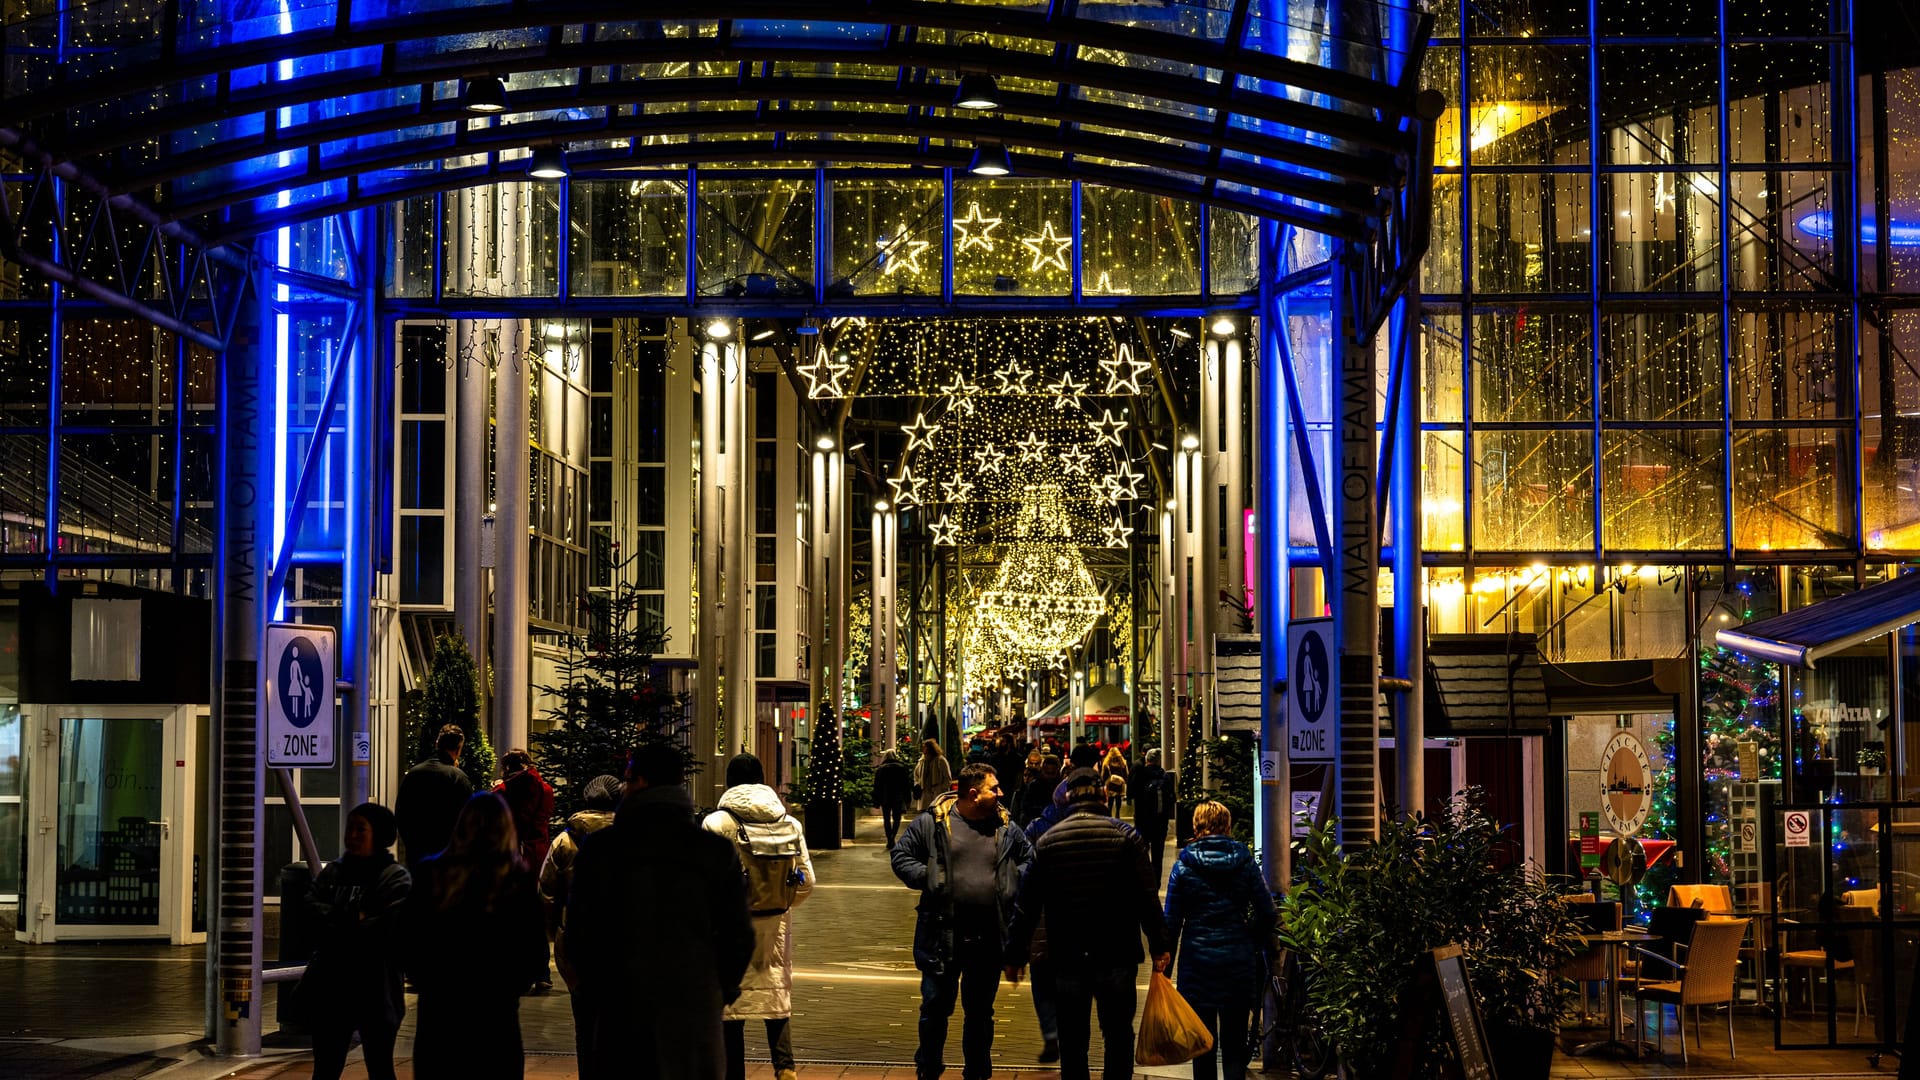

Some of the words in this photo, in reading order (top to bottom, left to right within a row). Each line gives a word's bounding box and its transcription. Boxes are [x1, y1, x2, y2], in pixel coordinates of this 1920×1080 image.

[231, 365, 259, 450] FAME
[1343, 357, 1369, 443] FAME
[231, 463, 257, 508] OF
[1343, 456, 1369, 501] OF
[228, 519, 256, 602] MALL
[1343, 512, 1369, 597] MALL
[1815, 702, 1872, 723] LAVAZZA
[283, 734, 318, 756] ZONE
[1300, 729, 1325, 751] ZONE
